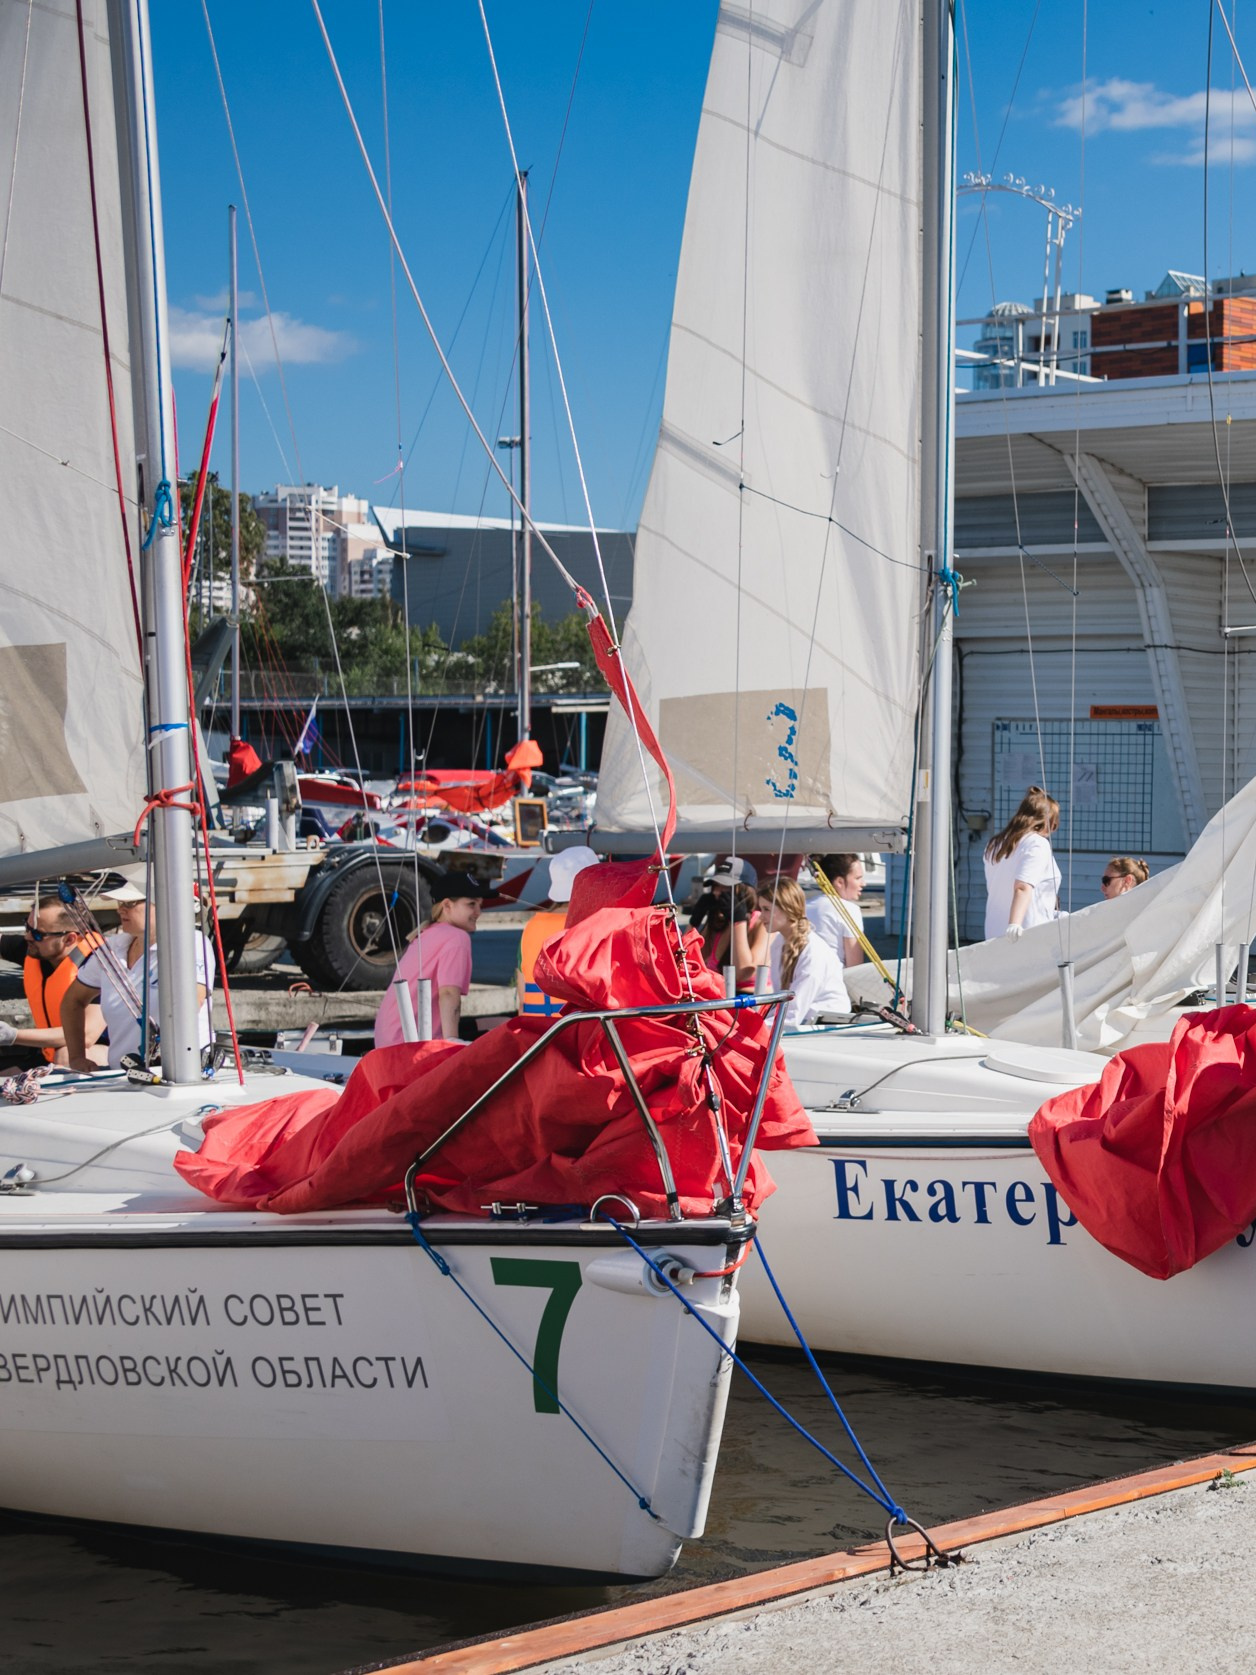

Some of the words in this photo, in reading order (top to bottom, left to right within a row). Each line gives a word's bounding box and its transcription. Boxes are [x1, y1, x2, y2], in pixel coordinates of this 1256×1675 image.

[224, 1293, 345, 1326] СОВЕТ
[489, 1256, 583, 1415] 7
[251, 1356, 429, 1389] ОБЛАСТИ
